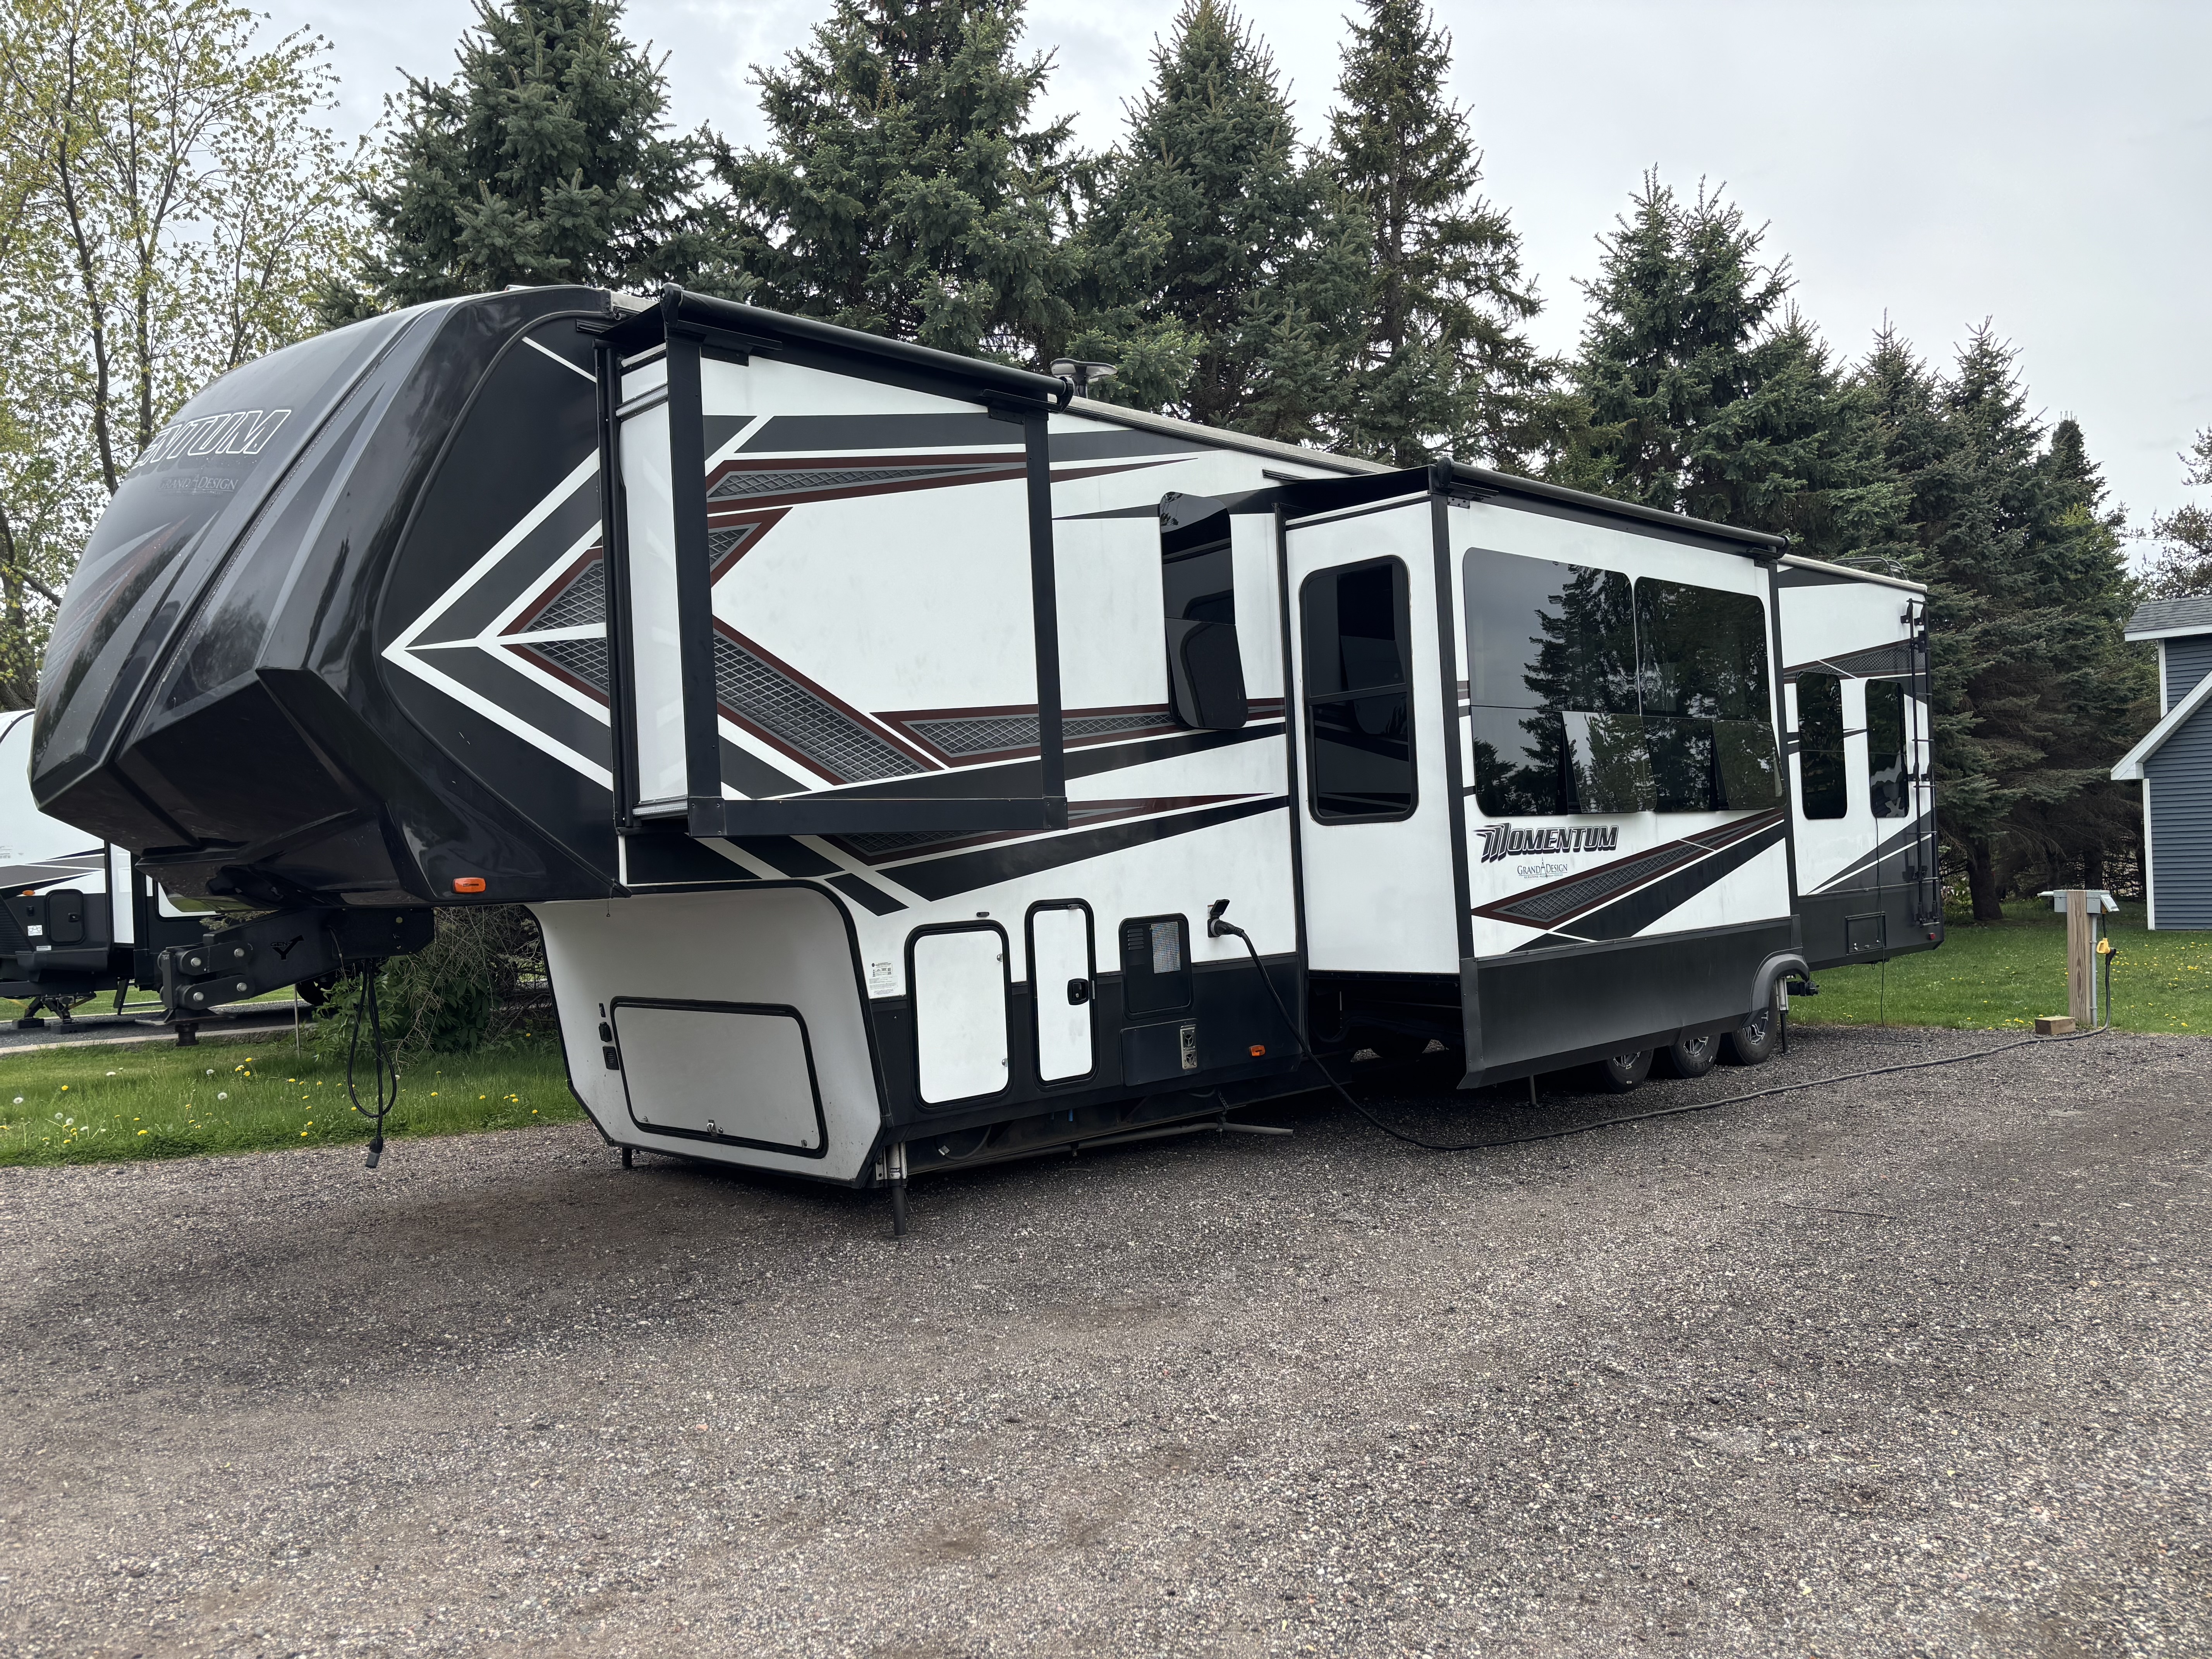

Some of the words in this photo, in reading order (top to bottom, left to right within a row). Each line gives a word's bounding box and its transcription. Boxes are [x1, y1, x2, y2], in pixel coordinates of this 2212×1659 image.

[198, 477, 239, 490] DESIGN
[1473, 823, 1619, 863] MOMENTUM
[1517, 865, 1540, 875] GRAND
[1546, 864, 1568, 873] DESIGN
